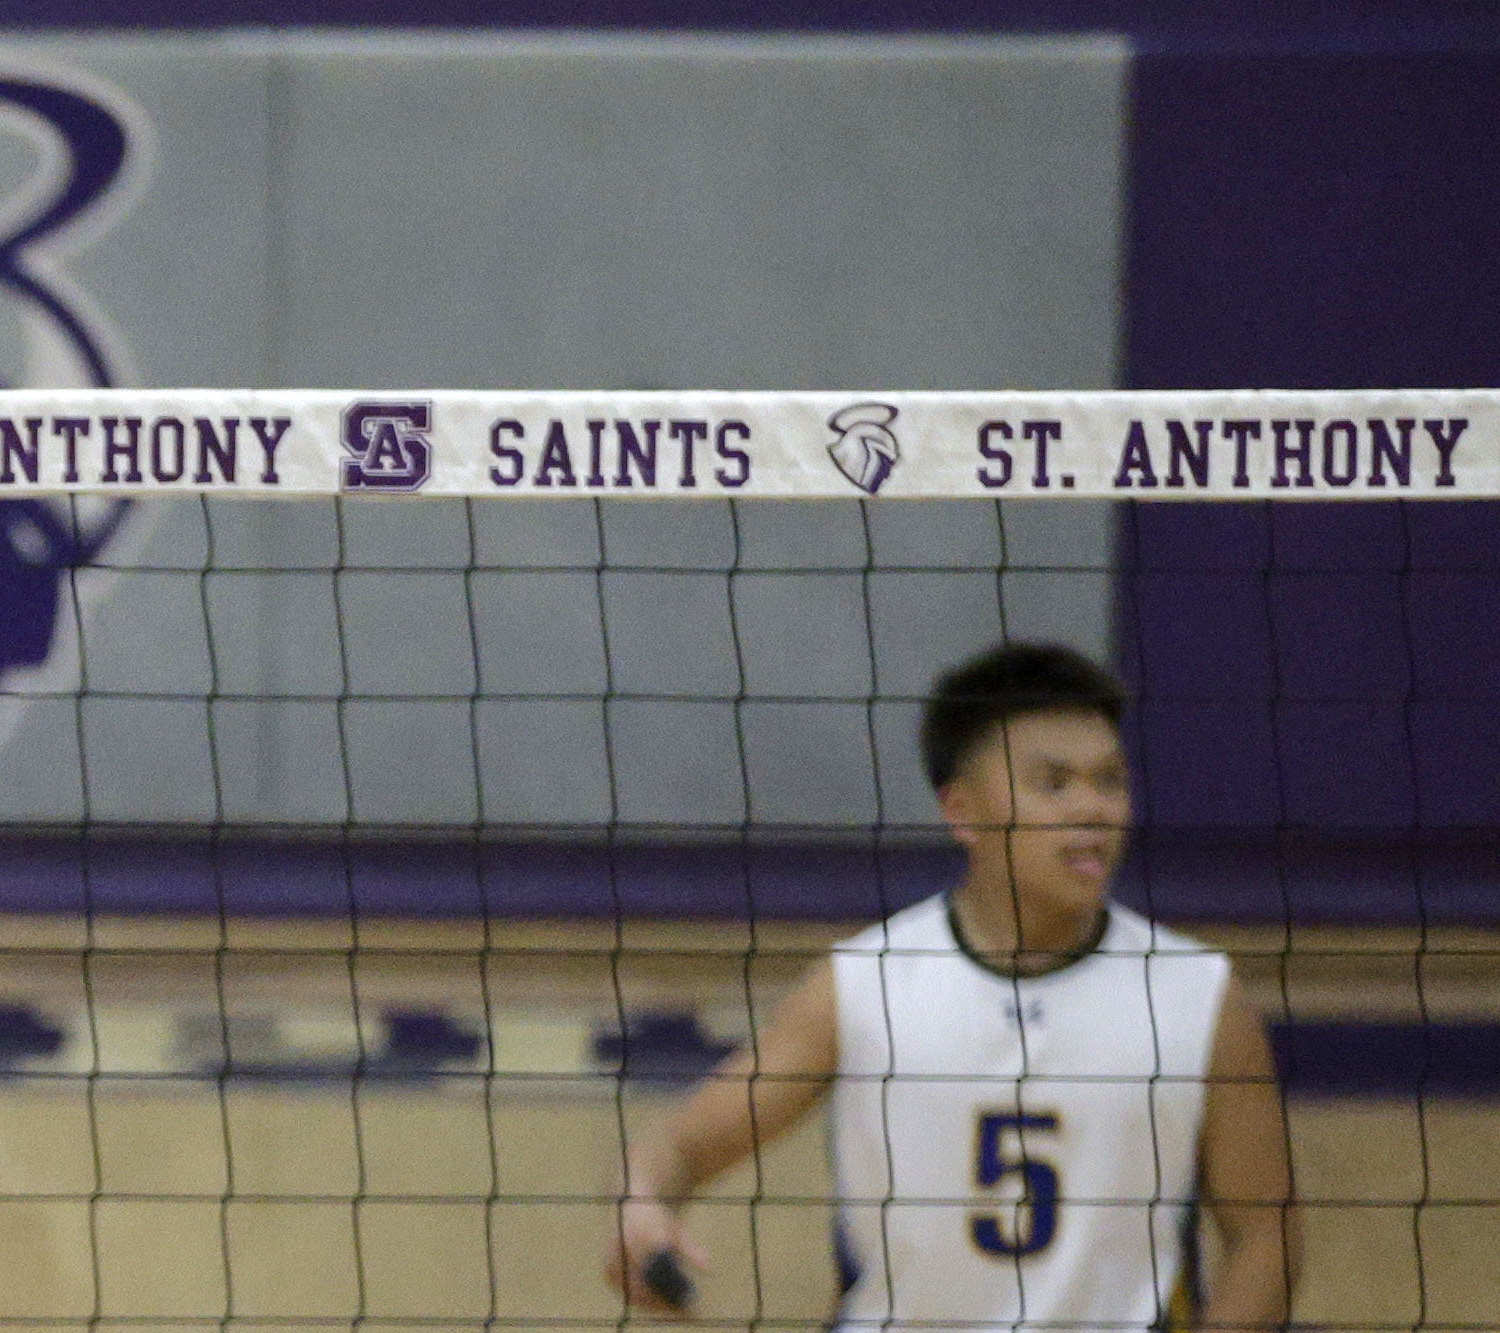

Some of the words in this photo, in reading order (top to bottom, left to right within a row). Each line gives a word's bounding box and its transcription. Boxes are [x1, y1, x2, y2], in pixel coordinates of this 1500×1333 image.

[489, 418, 752, 489] SAINTS
[976, 418, 1077, 490] ST.
[1112, 416, 1471, 490] ANTHONY
[969, 1107, 1063, 1258] 5
